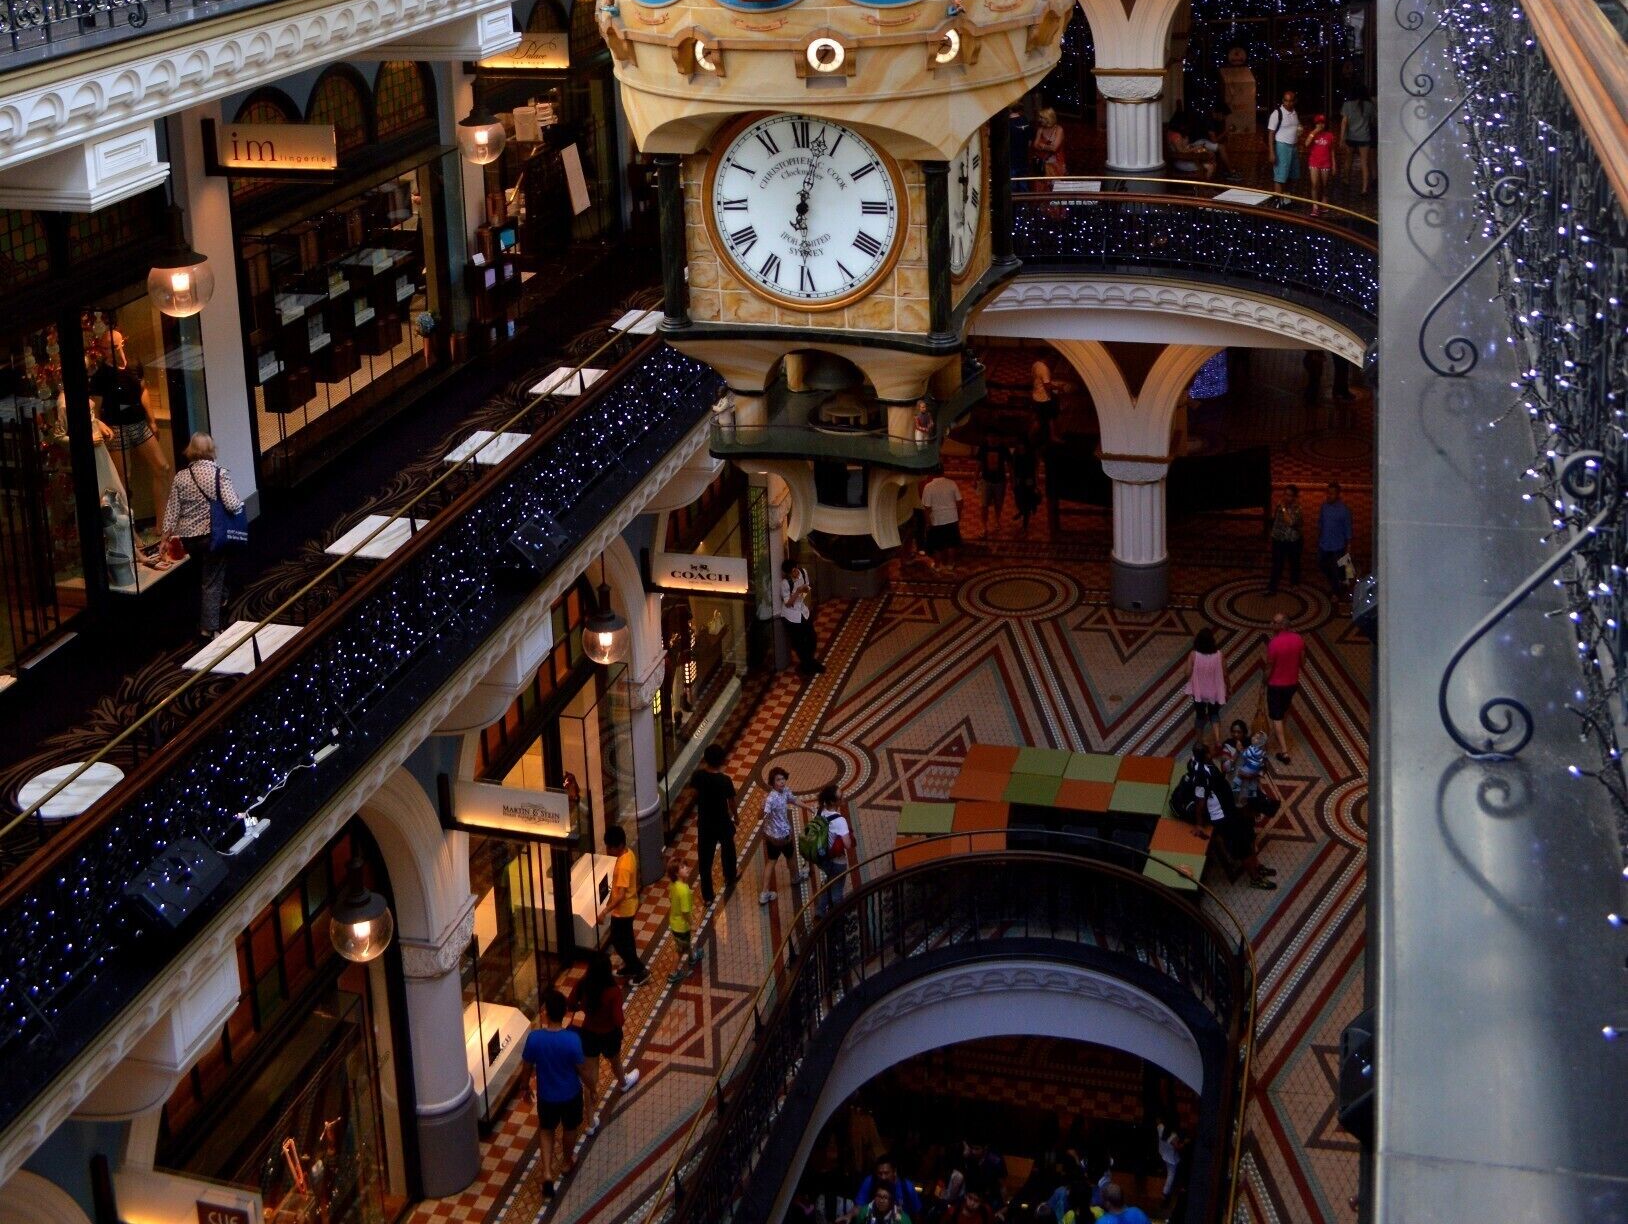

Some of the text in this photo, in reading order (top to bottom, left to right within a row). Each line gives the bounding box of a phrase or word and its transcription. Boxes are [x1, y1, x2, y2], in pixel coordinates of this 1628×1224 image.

[231, 131, 327, 164] im lingerie
[792, 121, 810, 149] XII
[826, 167, 848, 190] COOK
[671, 570, 730, 582] COACH
